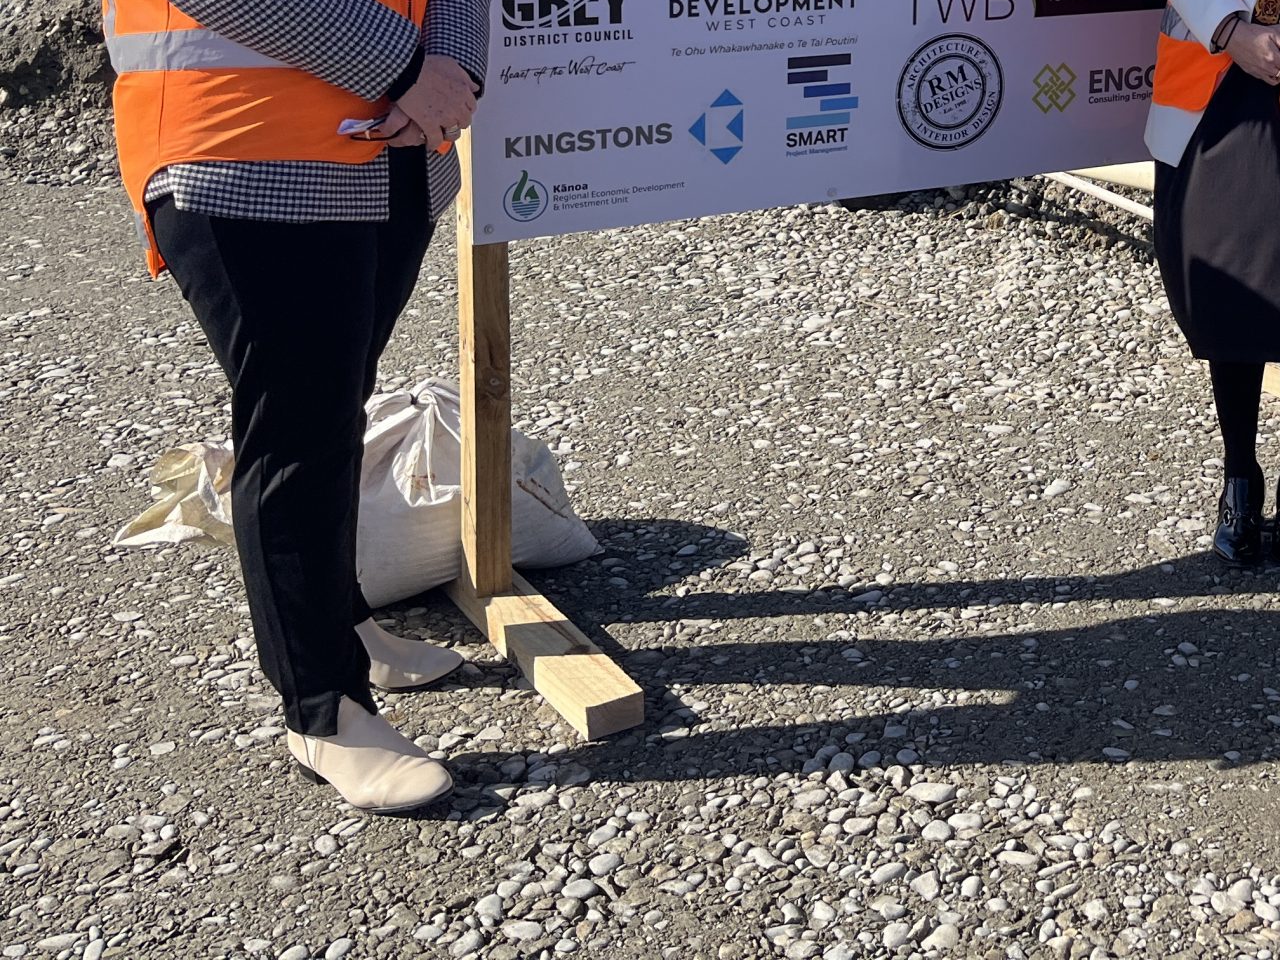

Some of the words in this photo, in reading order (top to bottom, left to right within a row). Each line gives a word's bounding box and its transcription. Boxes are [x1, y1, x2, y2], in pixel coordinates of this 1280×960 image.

[705, 18, 757, 32] WEST
[767, 14, 826, 28] COAST
[503, 33, 570, 47] DISTRICT
[575, 29, 634, 43] COUNCIL
[671, 48, 682, 57] Te
[684, 46, 706, 56] Ohu
[709, 41, 785, 55] Whakawhanake
[787, 41, 794, 49] o
[797, 39, 808, 48] Te
[810, 38, 823, 47] Tai
[825, 35, 859, 47] Poutini
[500, 65, 531, 85] Heart
[567, 55, 598, 76] West
[596, 61, 636, 76] Coast
[907, 42, 982, 91] ARCHITECTURE
[926, 63, 969, 98] RM
[922, 78, 982, 115] DESIGNS
[1088, 93, 1131, 104] Consulting
[916, 122, 969, 142] INTERIOR
[971, 90, 996, 131] DESIGN
[504, 122, 673, 159] KINGSTONS
[786, 127, 849, 148] SMART
[553, 183, 589, 194] Kānoa
[553, 191, 590, 203] Regional
[591, 186, 630, 199] Economic
[632, 181, 685, 194] Development
[553, 203, 560, 211] &
[562, 198, 609, 210] Investment
[611, 196, 628, 205] Unit
